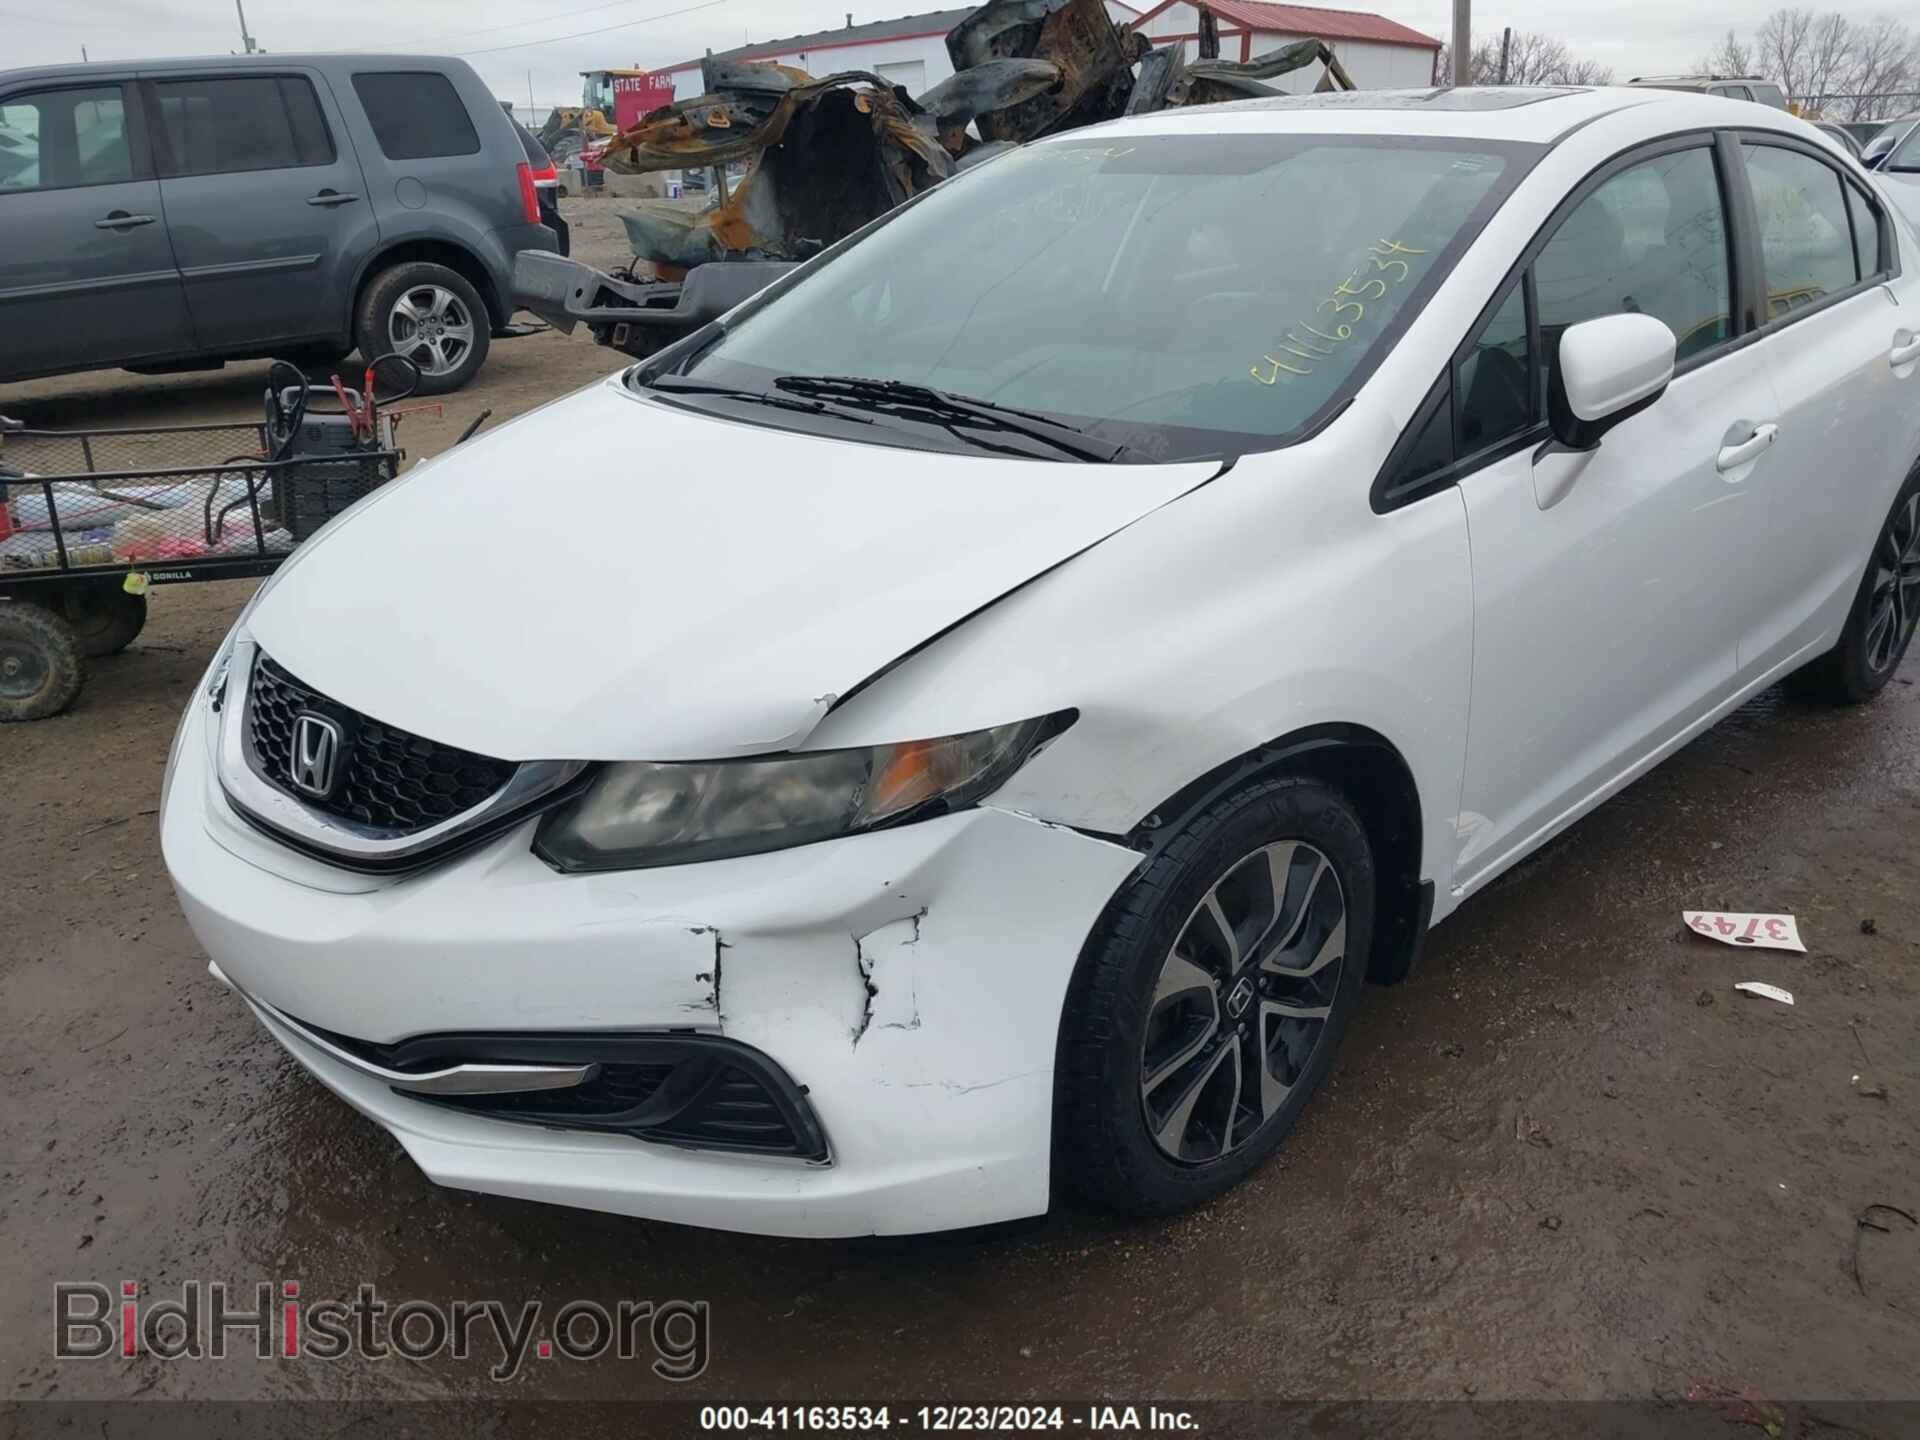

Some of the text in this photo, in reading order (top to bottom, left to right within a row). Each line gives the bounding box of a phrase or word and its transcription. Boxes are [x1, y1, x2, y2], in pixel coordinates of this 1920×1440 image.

[614, 74, 672, 93] STATE FARM
[1250, 238, 1428, 384] 41163534
[152, 571, 192, 580] GORILLA
